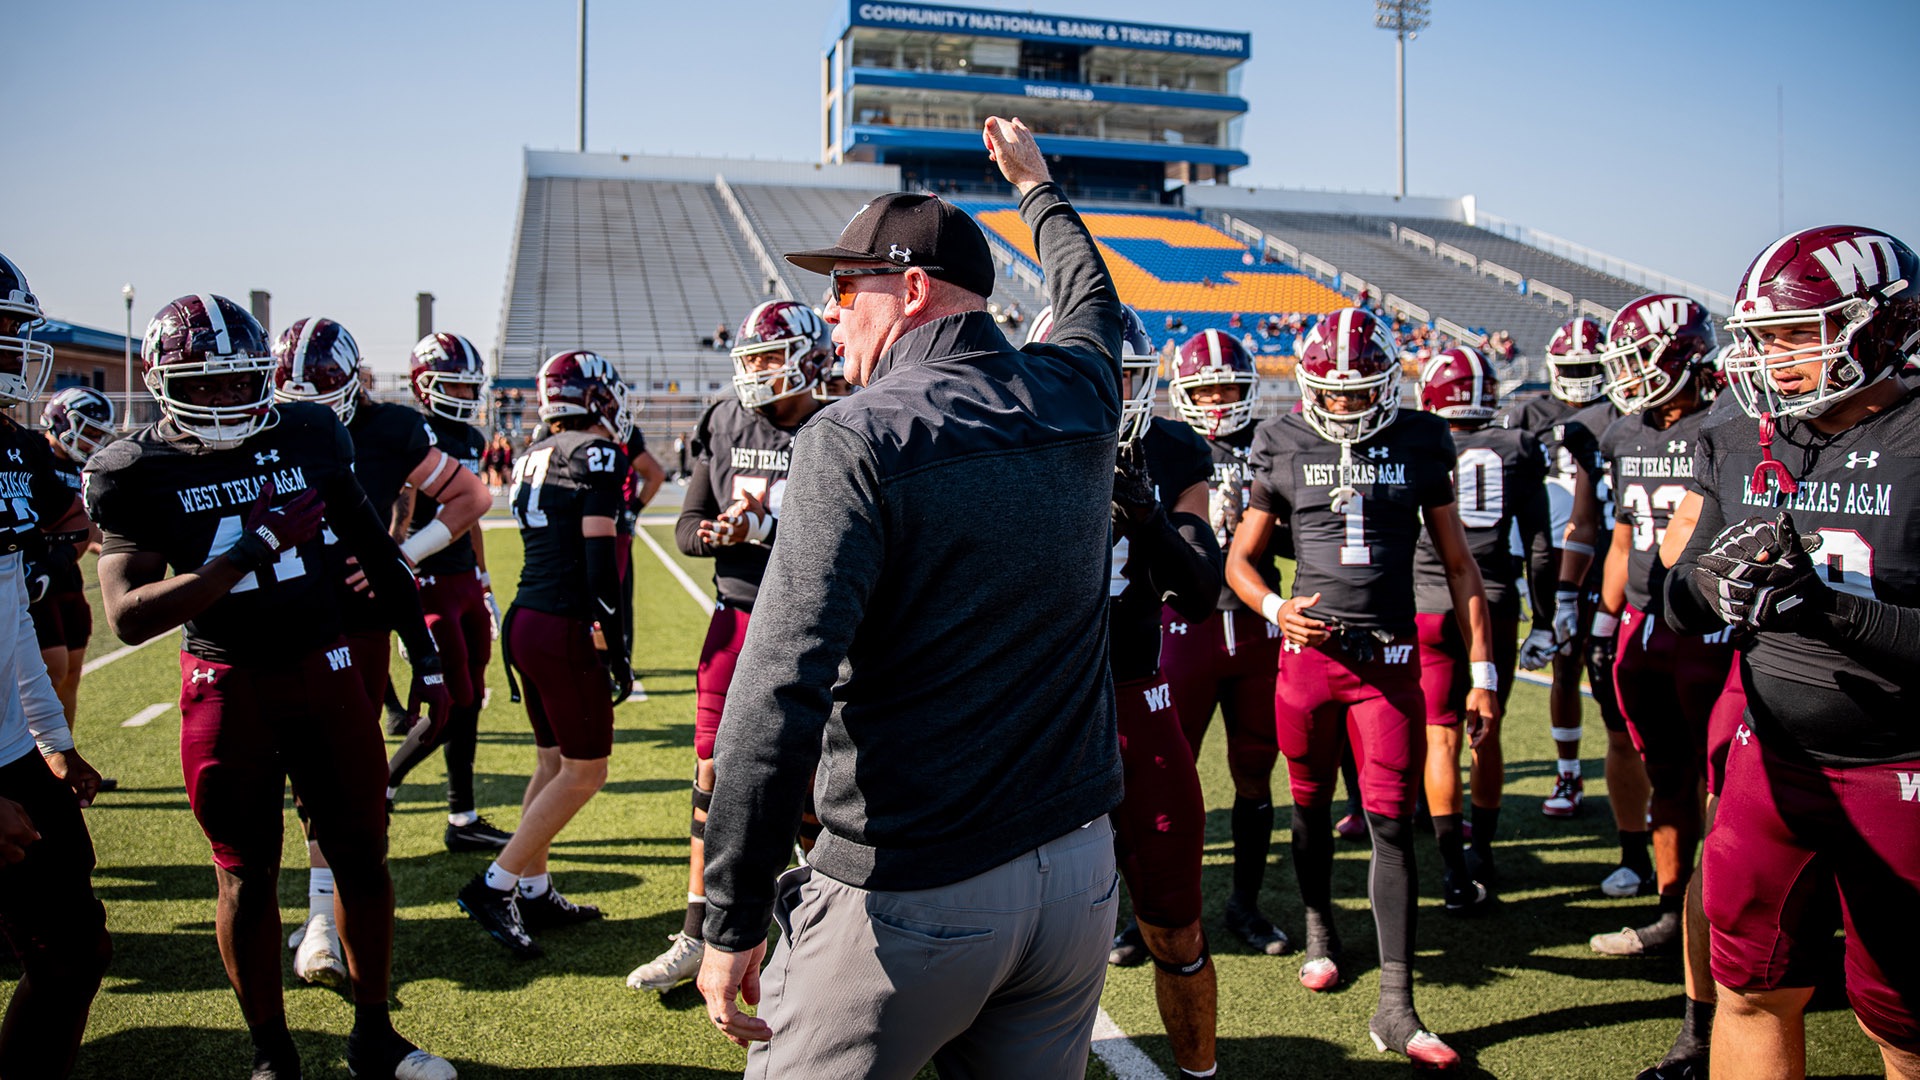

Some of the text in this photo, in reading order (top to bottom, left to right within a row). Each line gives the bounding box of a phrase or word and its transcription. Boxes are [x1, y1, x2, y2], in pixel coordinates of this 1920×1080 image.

[859, 3, 1244, 53] COMMUNITY NATIONAL BANK & TRUST STADIUM
[1024, 84, 1095, 101] TIGER FIELD
[1810, 235, 1901, 298] WT
[1636, 297, 1693, 334] WT
[587, 446, 616, 473] 27
[731, 447, 789, 471] WEST TEXAS
[1621, 456, 1641, 477] WEST
[1641, 457, 1671, 477] TEXAS
[1303, 463, 1335, 486] WEST
[1378, 463, 1406, 485] A&M
[177, 484, 222, 514] WEST
[272, 466, 307, 496] A&M
[1844, 482, 1892, 516] A&M
[1340, 492, 1371, 566] 1
[325, 646, 352, 671] WT
[1383, 645, 1413, 664] WT
[1143, 683, 1171, 712] WT
